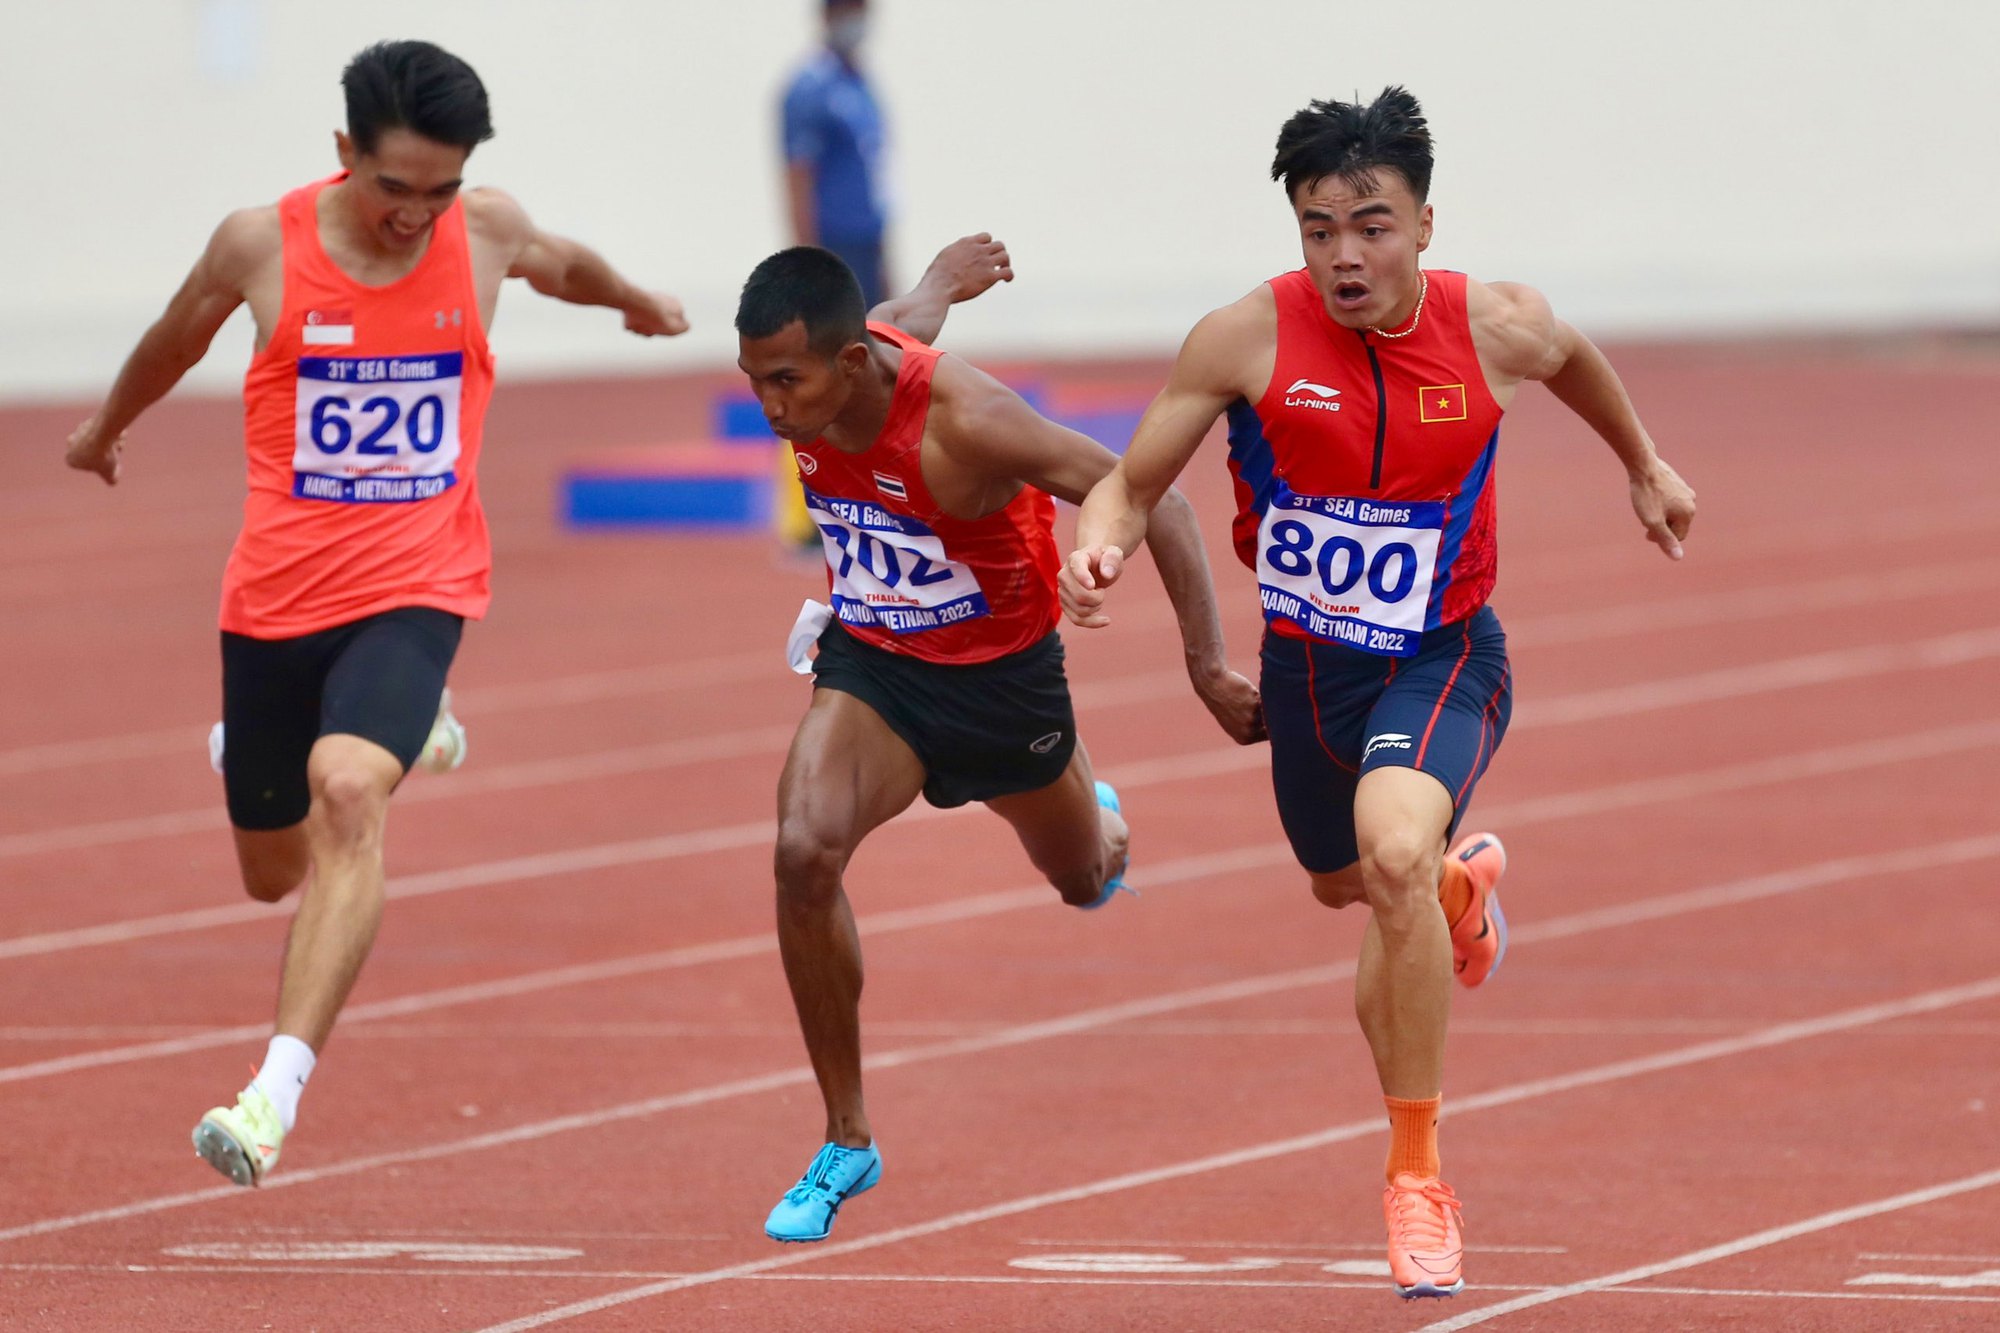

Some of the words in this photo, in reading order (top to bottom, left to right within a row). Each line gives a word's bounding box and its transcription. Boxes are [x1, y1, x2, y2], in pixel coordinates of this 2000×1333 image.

[356, 360, 387, 381] SEA
[389, 359, 437, 380] Games
[1285, 397, 1341, 412] LI-NING
[310, 395, 444, 455] 620
[353, 479, 413, 501] VIETNAM
[831, 503, 859, 525] SEA
[1324, 498, 1355, 519] SEA
[1358, 503, 1411, 523] Games
[818, 524, 953, 589] 702
[1266, 520, 1417, 604] 800
[839, 602, 876, 623] HANOI
[939, 600, 975, 623] 2022
[1309, 592, 1360, 614] VIETNAM
[1261, 589, 1301, 619] HANOI
[1309, 610, 1368, 645] VIETNAM
[1368, 629, 1405, 651] 2022
